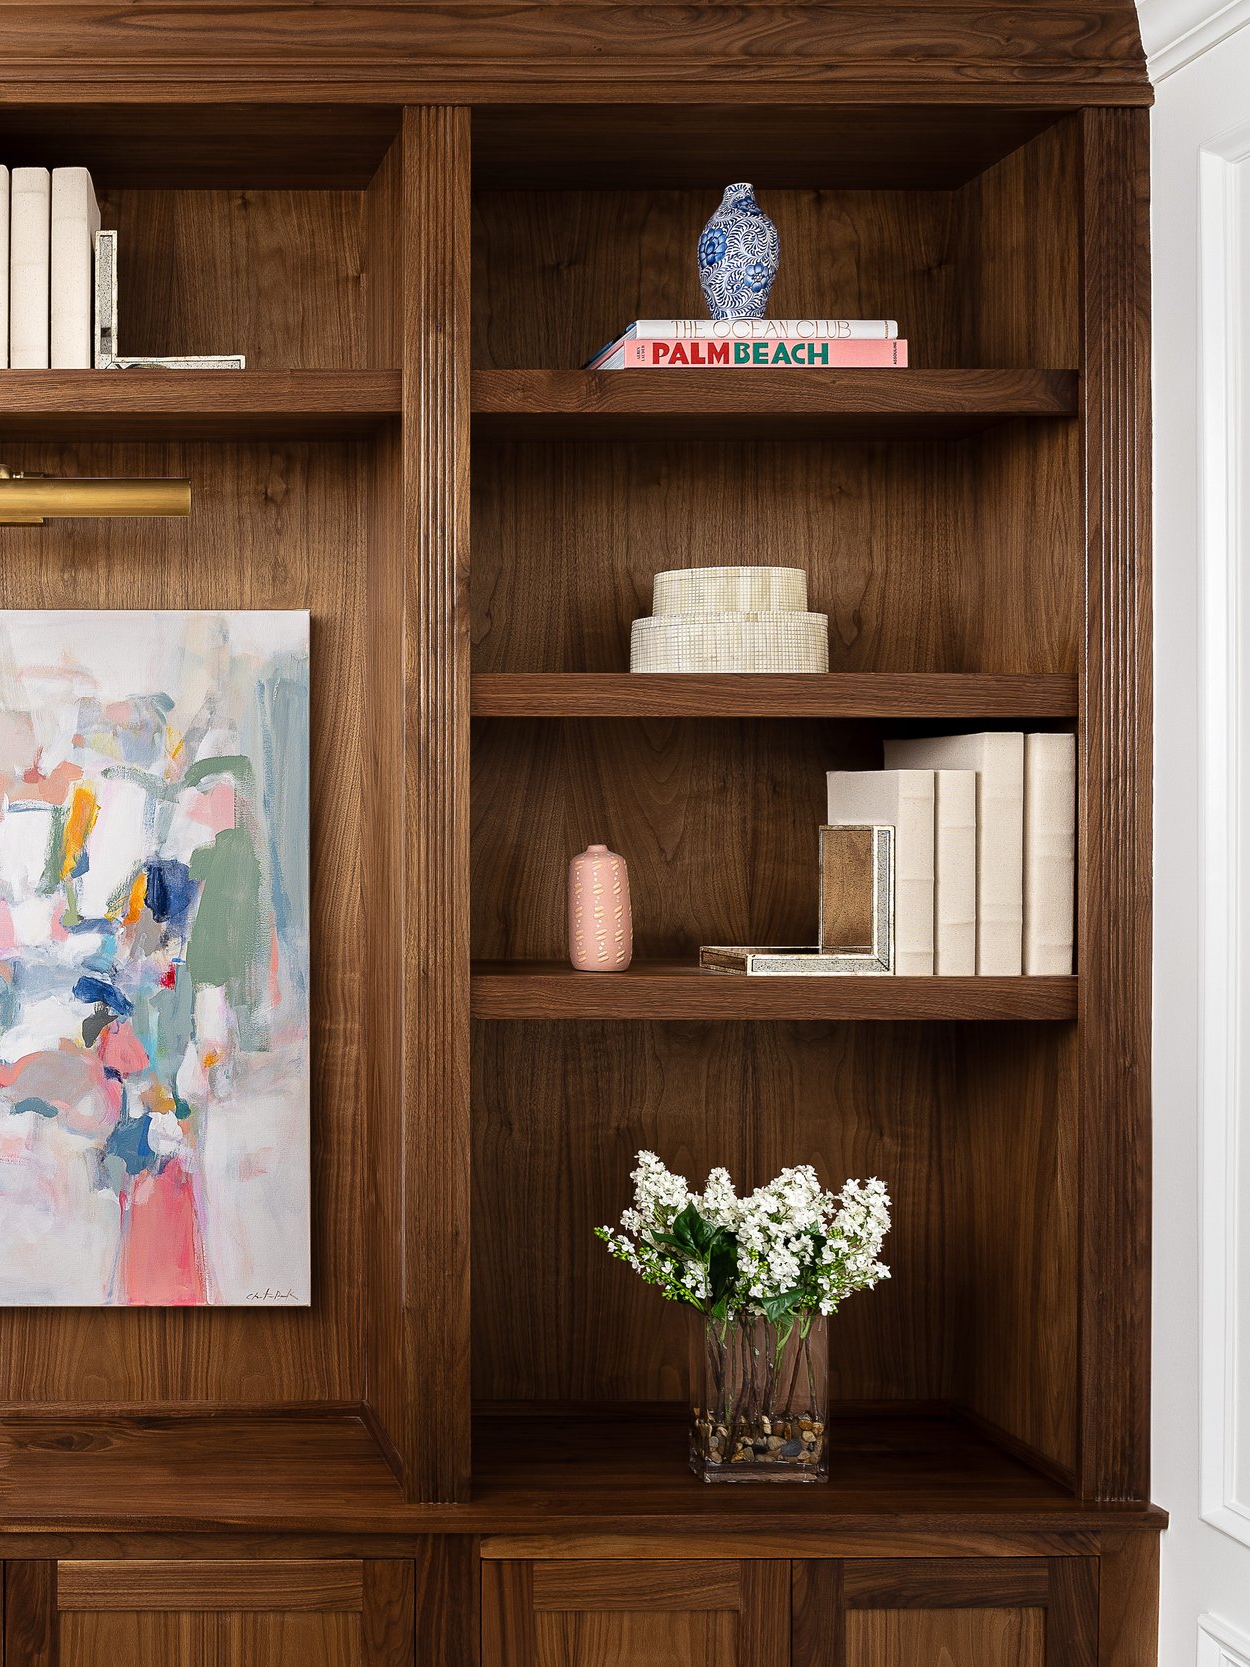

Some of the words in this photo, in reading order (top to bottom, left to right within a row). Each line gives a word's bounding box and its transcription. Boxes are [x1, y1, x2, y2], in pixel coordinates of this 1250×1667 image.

[671, 321, 706, 339] THE
[712, 321, 788, 339] OCEAN
[796, 321, 852, 339] CLUB
[652, 342, 730, 365] PALM
[734, 342, 829, 365] BEACH
